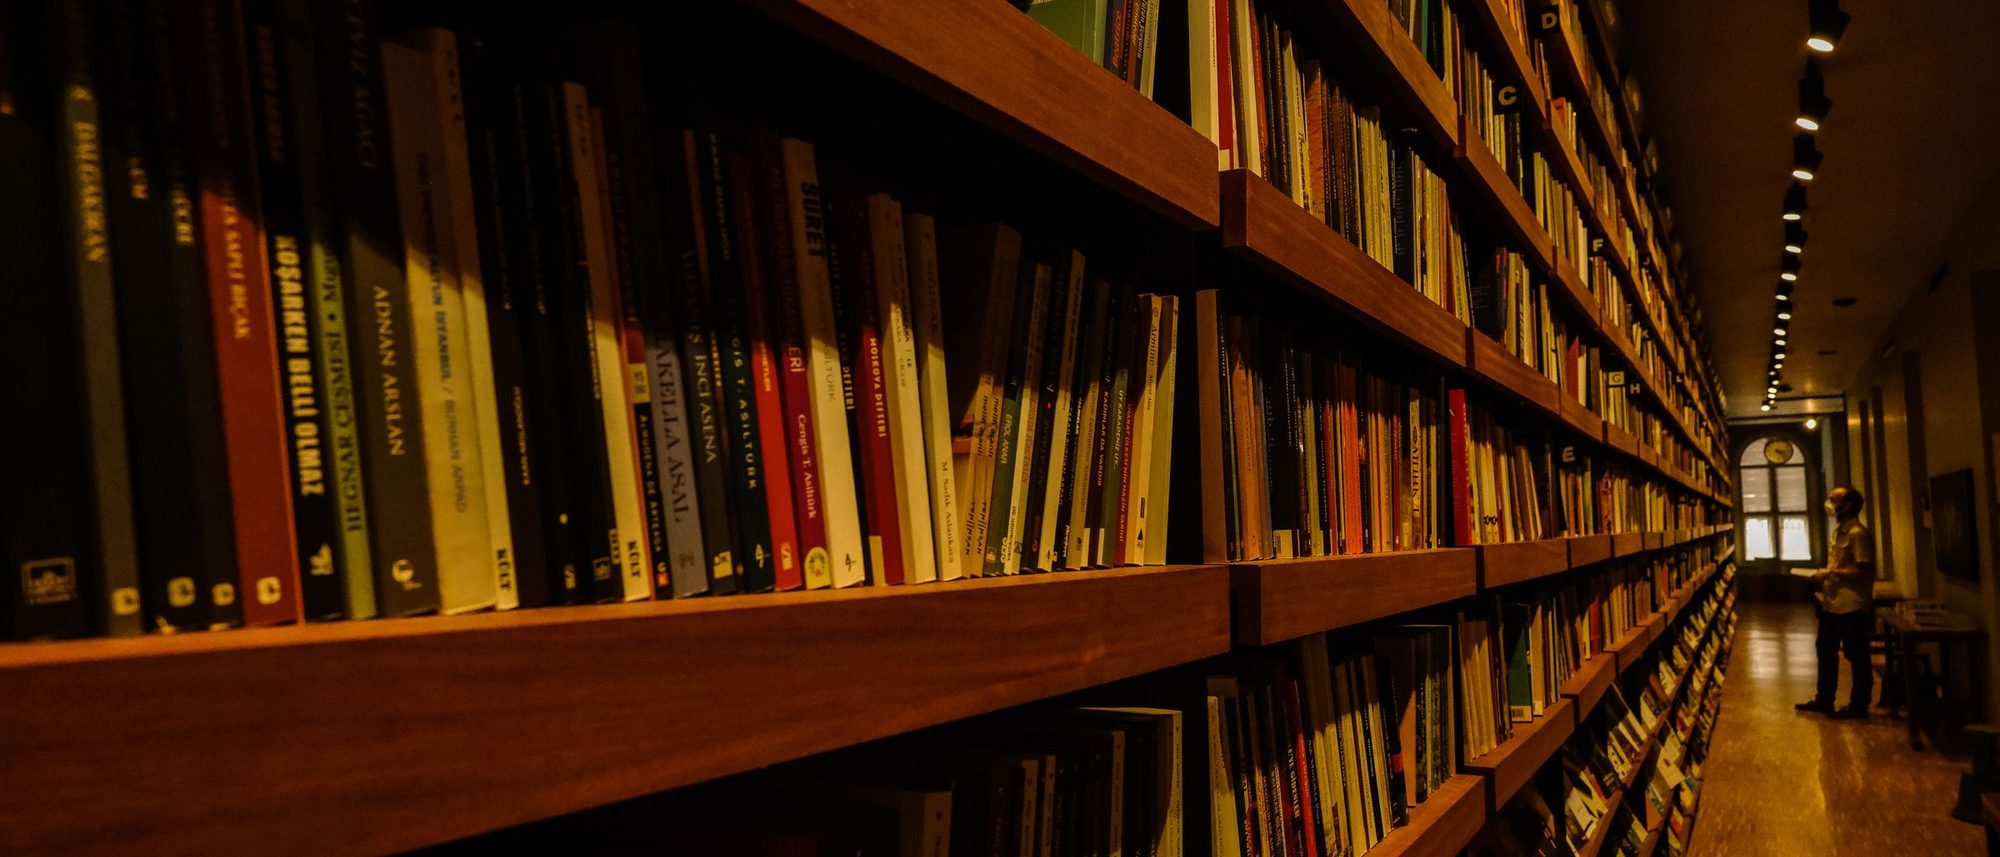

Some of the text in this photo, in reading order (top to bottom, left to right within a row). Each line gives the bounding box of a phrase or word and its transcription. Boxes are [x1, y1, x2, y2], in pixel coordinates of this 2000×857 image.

[1540, 12, 1558, 30] D
[1498, 85, 1517, 106] C
[1592, 238, 1605, 253] F
[273, 233, 326, 497] KOŞARKEN BELLİ OLMAZ
[371, 284, 407, 457] ADNAN ARSLAN
[869, 337, 885, 390] MOSKOVA
[1629, 382, 1641, 395] H
[699, 401, 718, 465] ASENA
[1561, 446, 1577, 464] E
[338, 435, 364, 533] HEGNAR
[661, 455, 690, 524] ASAL
[496, 547, 513, 593] KÜLT
